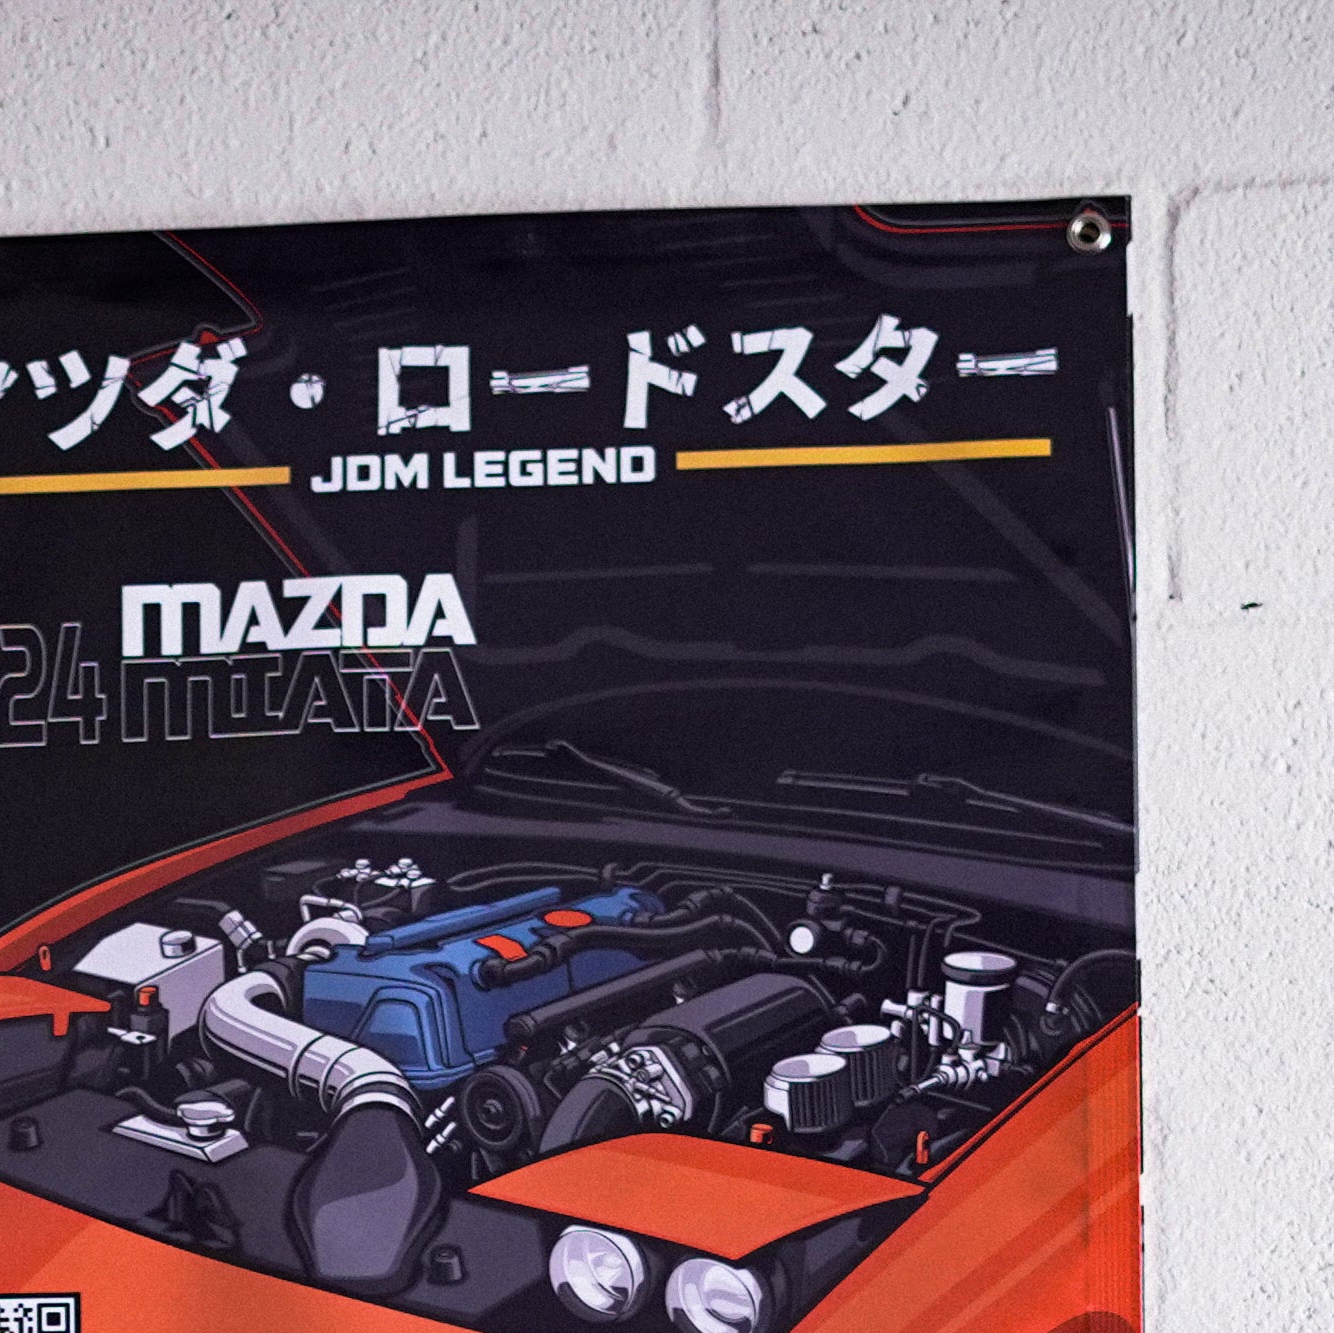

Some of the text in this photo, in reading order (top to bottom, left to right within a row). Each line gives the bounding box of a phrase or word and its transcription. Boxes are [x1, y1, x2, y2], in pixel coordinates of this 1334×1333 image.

[310, 445, 656, 493] JDM LEGEND
[121, 573, 477, 657] MAZDA
